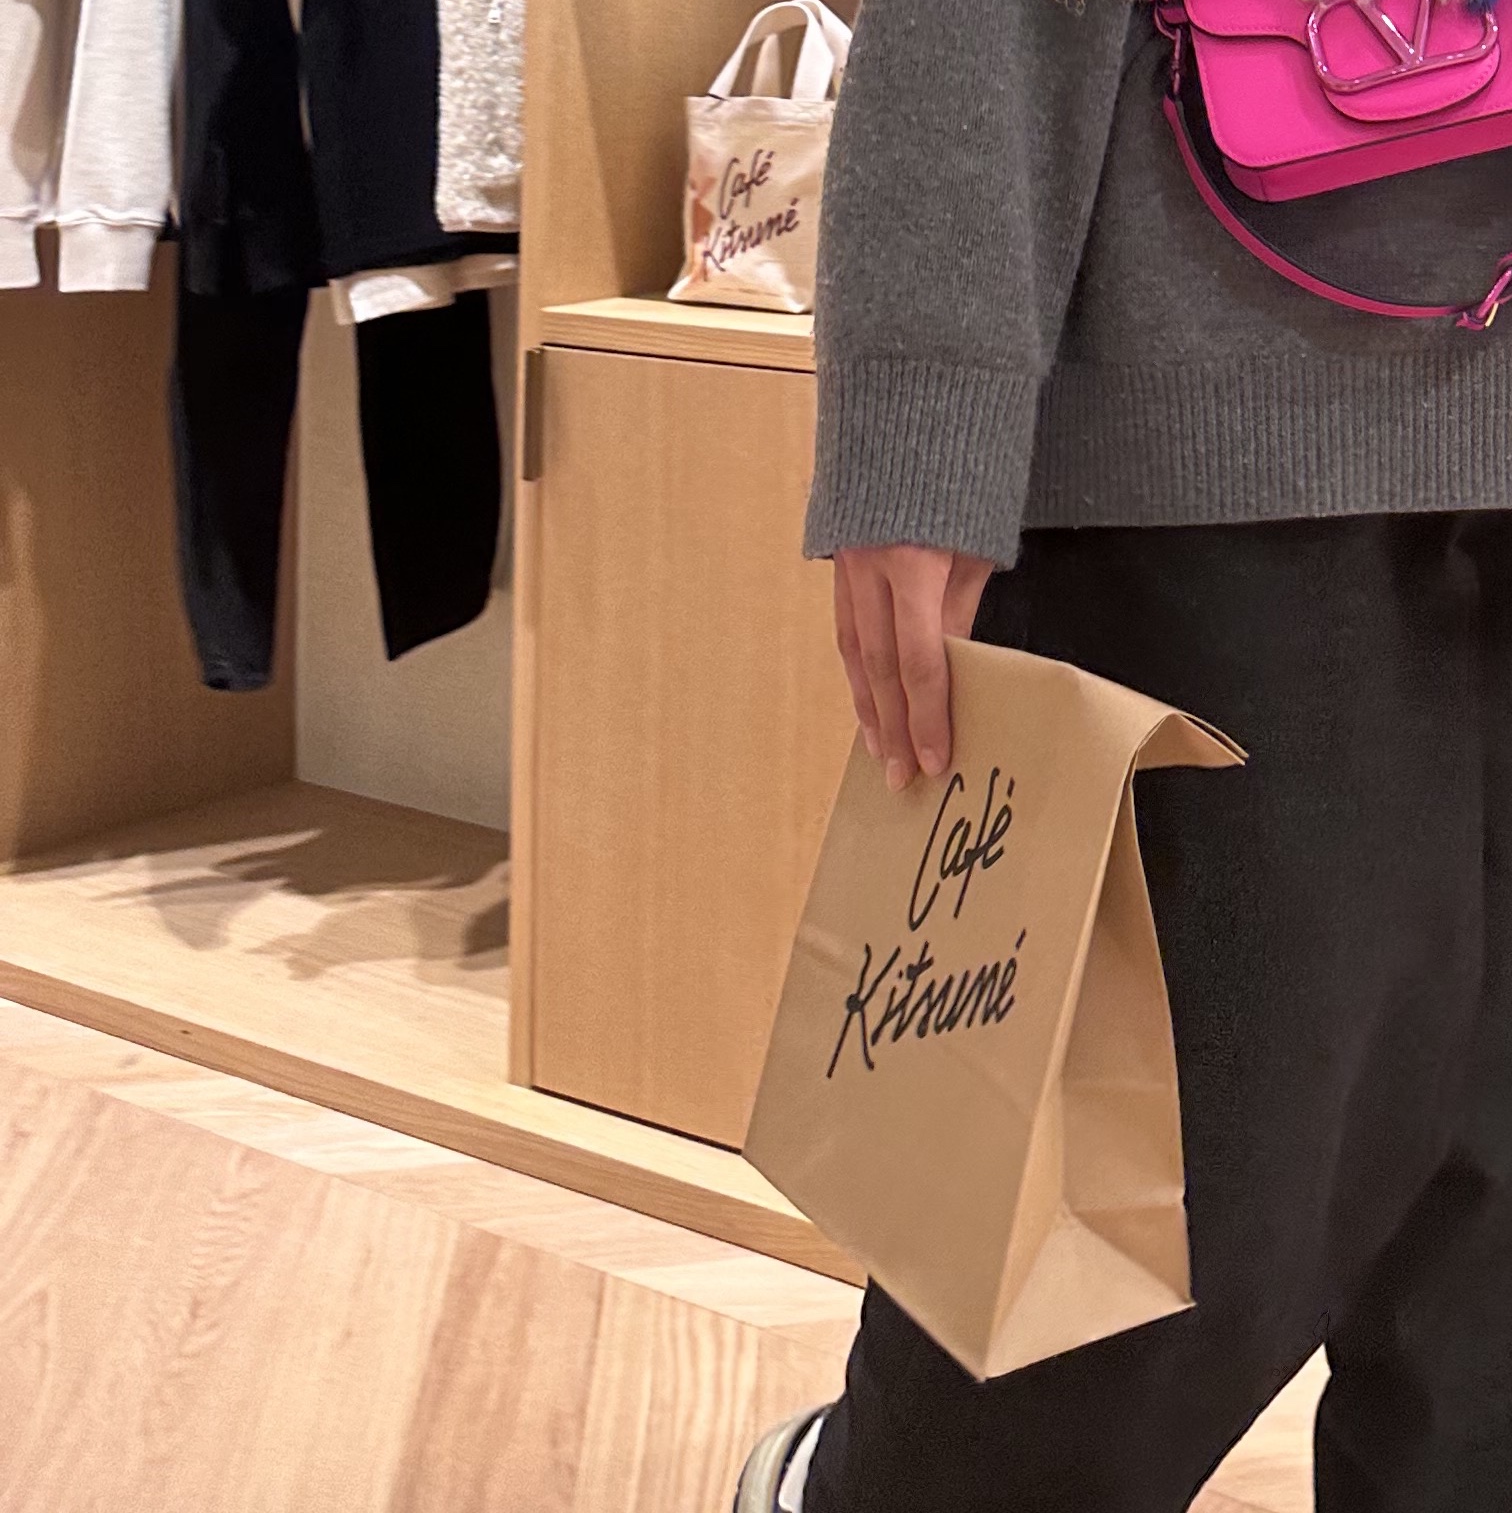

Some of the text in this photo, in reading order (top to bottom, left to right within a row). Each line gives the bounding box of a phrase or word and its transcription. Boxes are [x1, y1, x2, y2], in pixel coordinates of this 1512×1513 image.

[702, 197, 800, 282] Kitsuné
[718, 149, 774, 220] Café
[908, 767, 1016, 931] Café
[826, 928, 1027, 1079] Kitsuné
